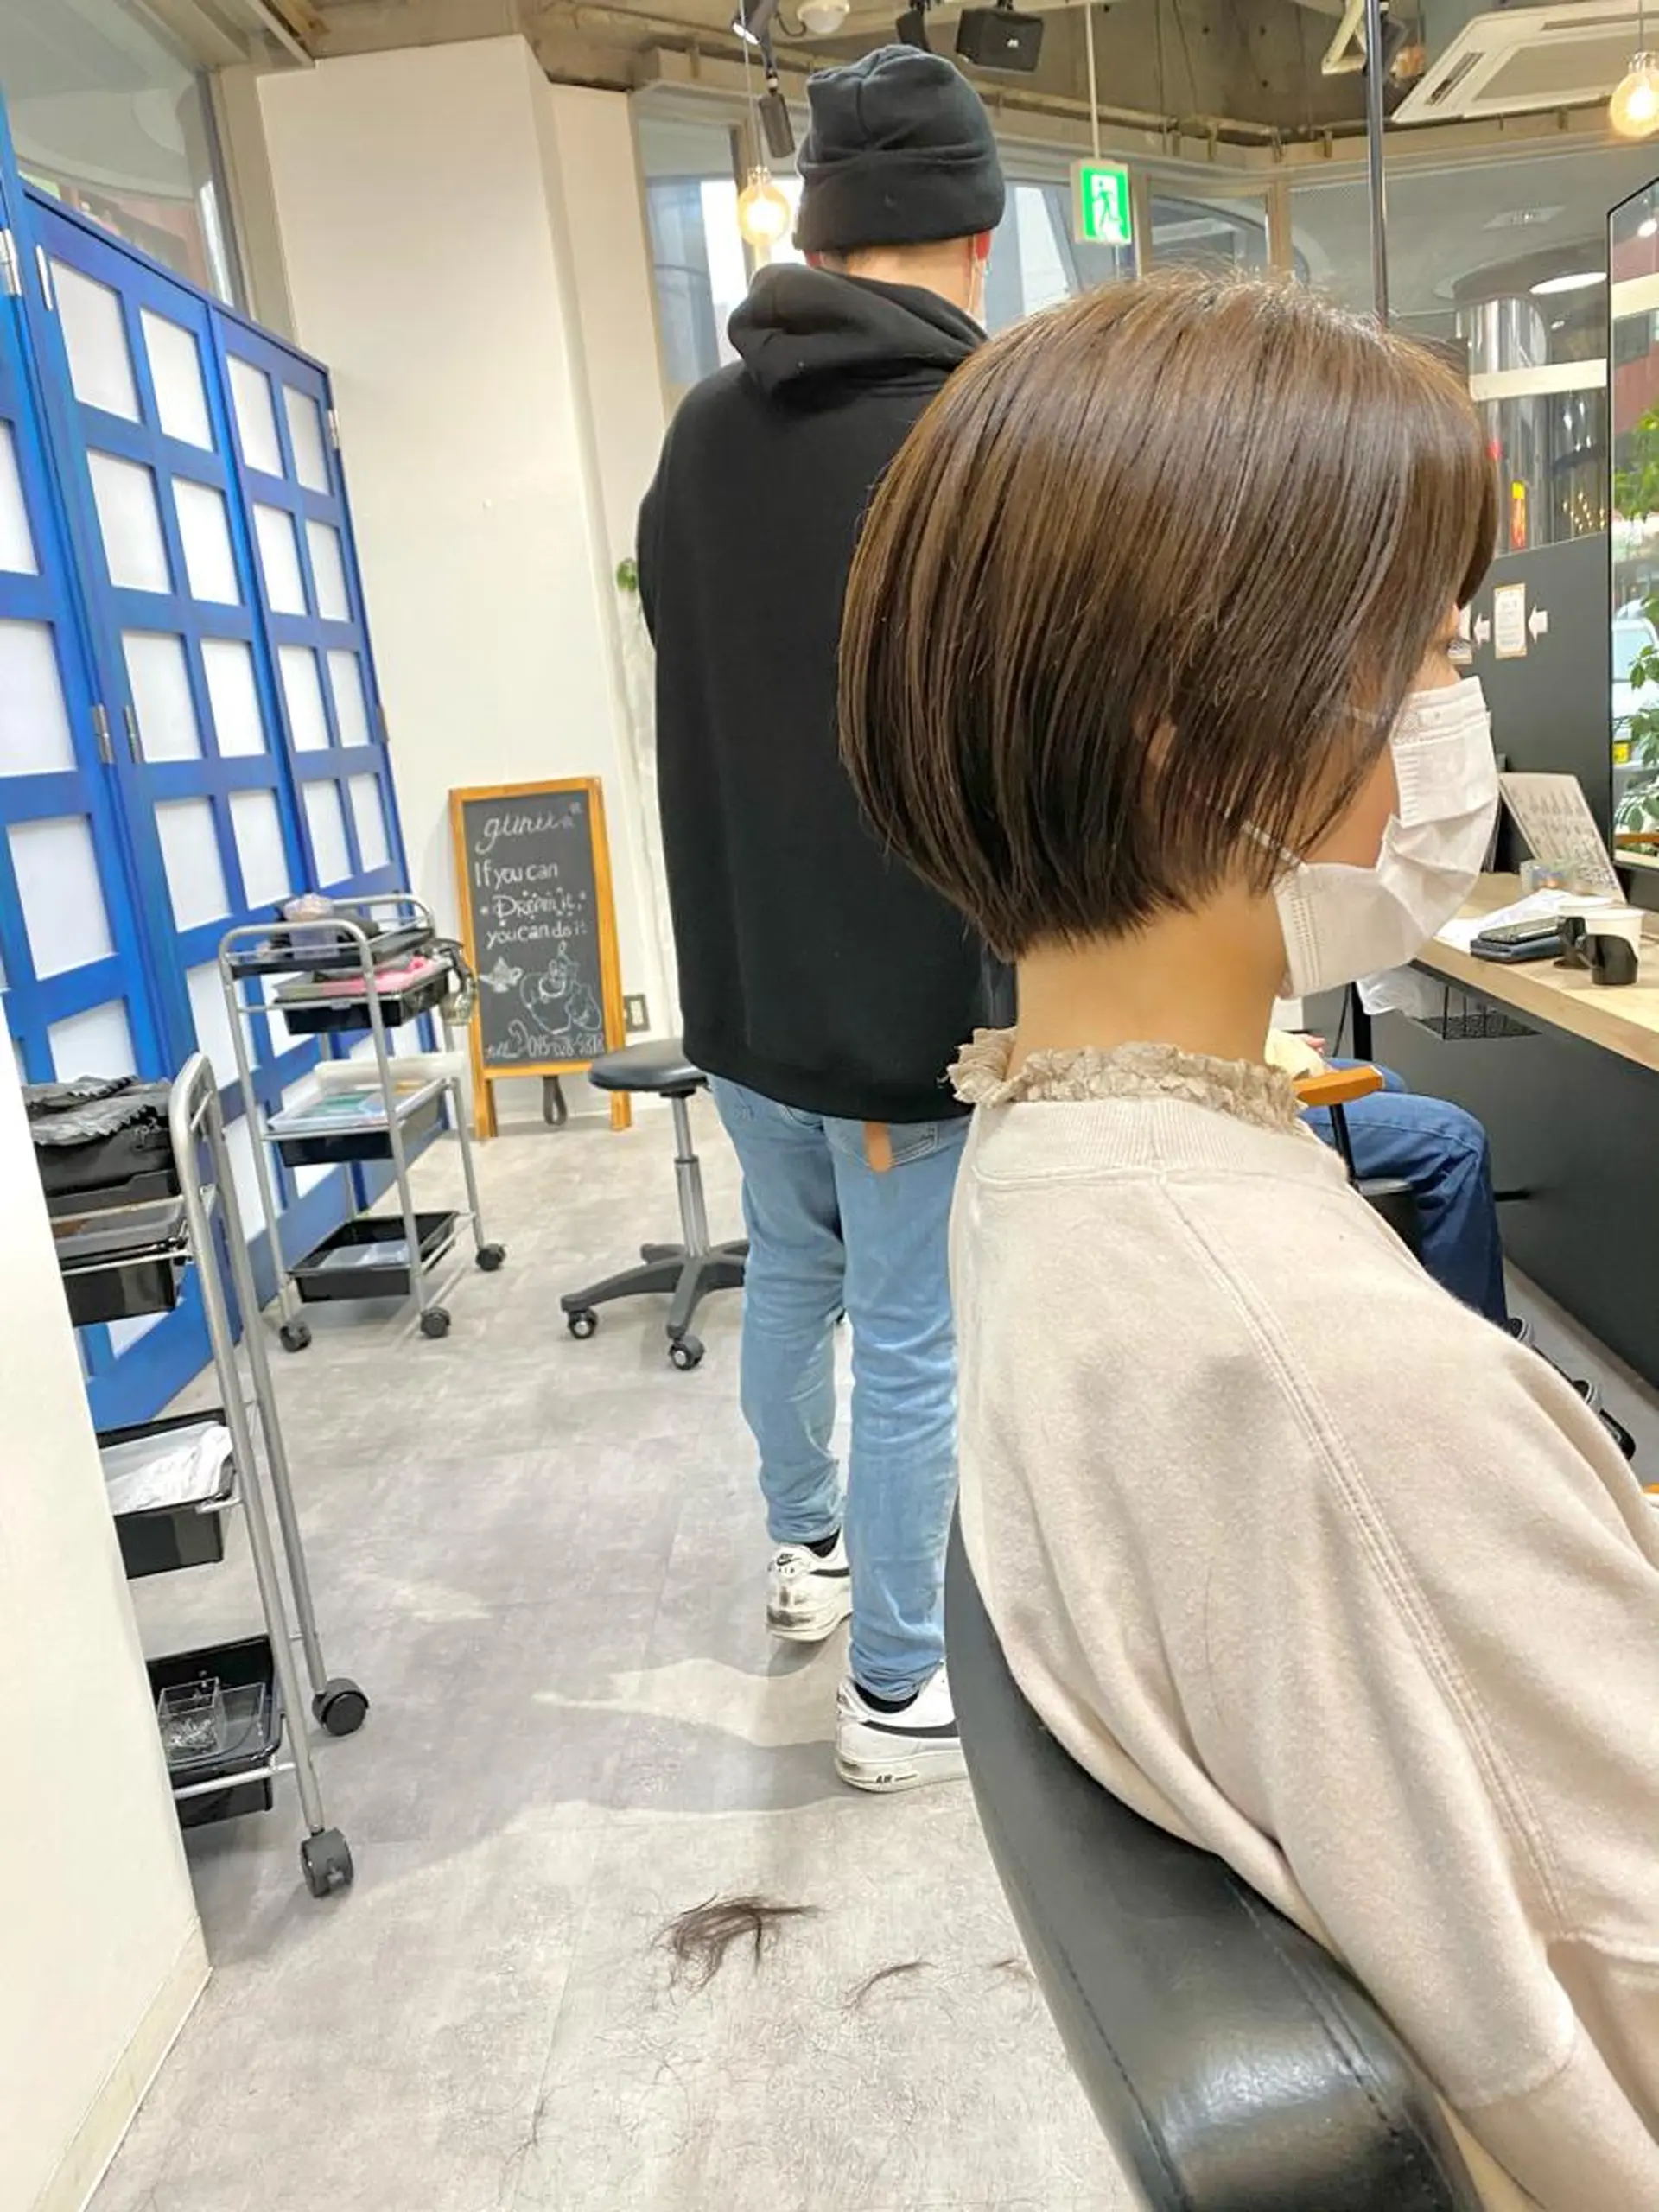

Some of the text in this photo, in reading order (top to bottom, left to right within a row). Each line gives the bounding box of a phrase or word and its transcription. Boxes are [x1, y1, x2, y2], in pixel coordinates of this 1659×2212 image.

[524, 862, 559, 881] can
[517, 924, 550, 943] can
[551, 919, 572, 938] do
